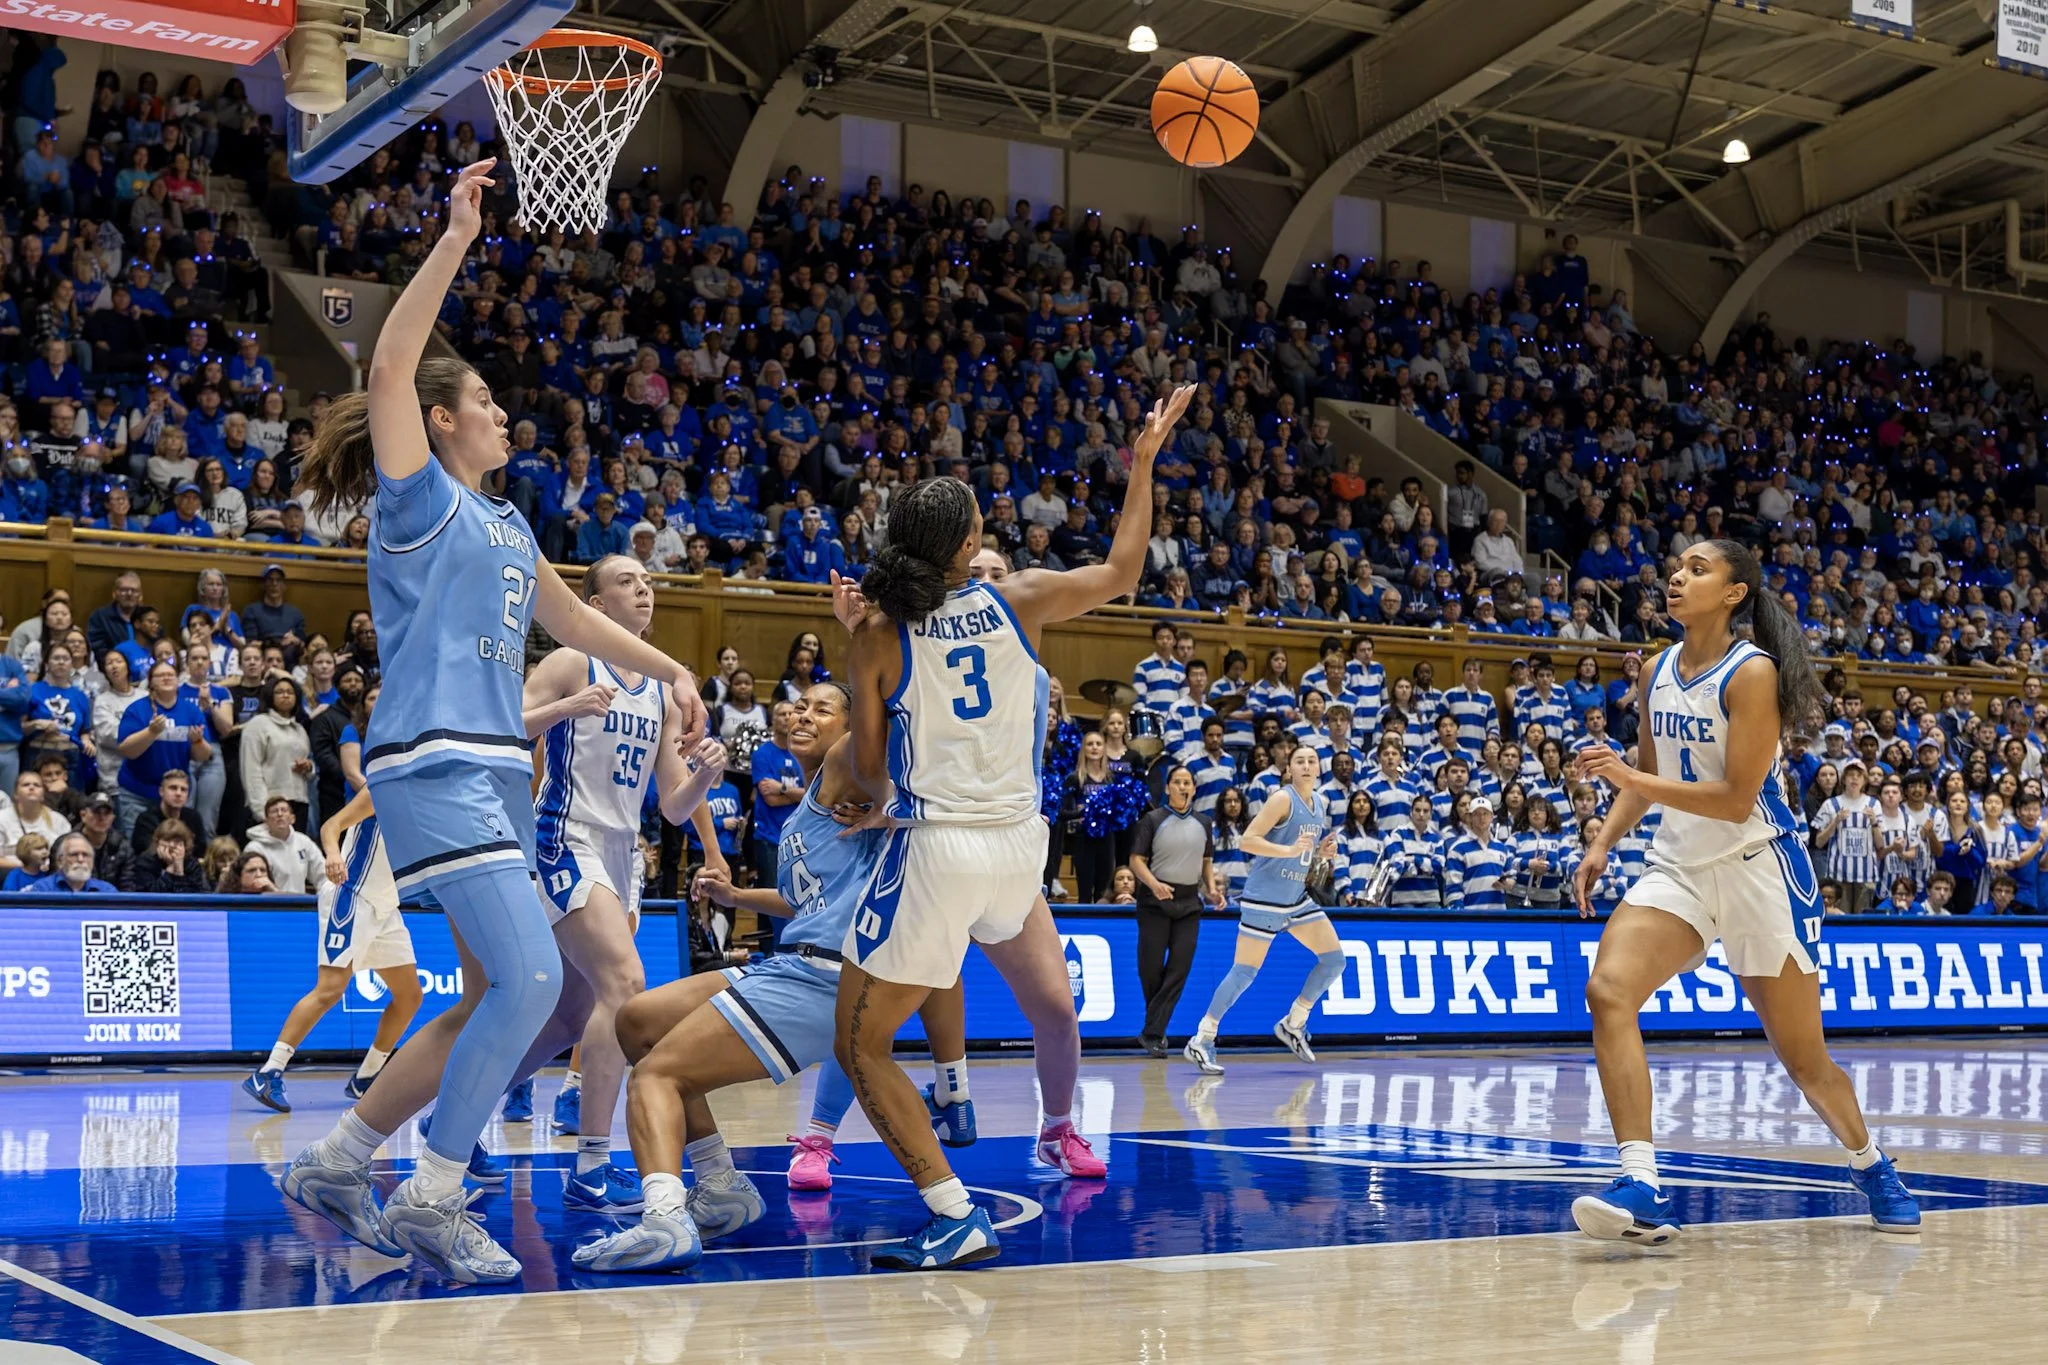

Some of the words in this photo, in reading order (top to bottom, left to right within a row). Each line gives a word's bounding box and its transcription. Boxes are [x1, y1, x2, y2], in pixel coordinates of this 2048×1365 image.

[2016, 39, 2040, 56] 2010
[327, 298, 349, 319] 15
[914, 604, 1004, 640] JACKSON
[945, 644, 992, 720] 3
[603, 710, 659, 743] DUKE
[1653, 711, 1716, 743] DUKE
[612, 743, 648, 789] 35
[549, 869, 573, 896] D
[856, 905, 882, 941] D
[327, 933, 346, 949] D
[1322, 939, 1558, 1016] DUKE
[84, 1023, 131, 1042] JOIN
[137, 1023, 181, 1041] NOW
